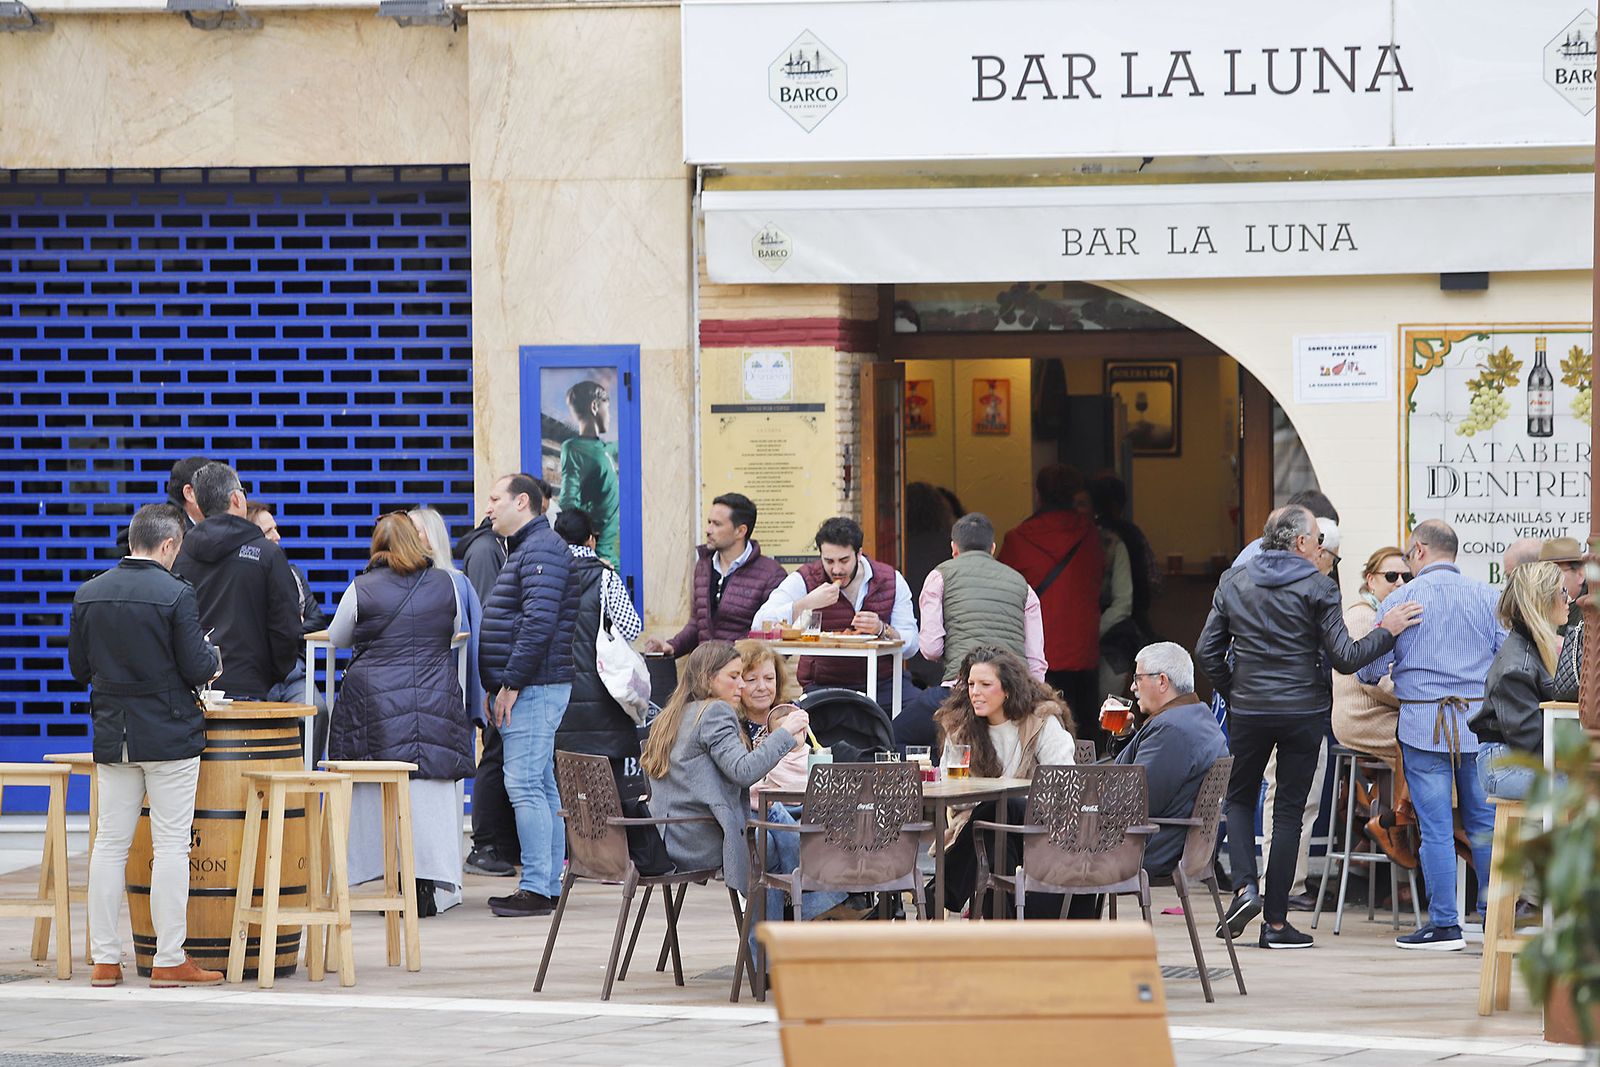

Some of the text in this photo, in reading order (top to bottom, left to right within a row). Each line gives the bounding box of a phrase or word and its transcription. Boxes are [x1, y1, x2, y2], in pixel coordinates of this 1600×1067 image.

[972, 45, 1414, 102] BAR LA LUNA
[1555, 67, 1596, 84] BAR
[780, 86, 838, 102] BARCO
[1062, 223, 1358, 256] BAR LA LUNA
[757, 249, 788, 258] BARCO
[1439, 443, 1477, 463] LA
[1455, 511, 1552, 524] MANZANILLAS
[1557, 511, 1567, 523] Y
[1514, 526, 1569, 538] VERMUT
[1463, 541, 1511, 554] COND
